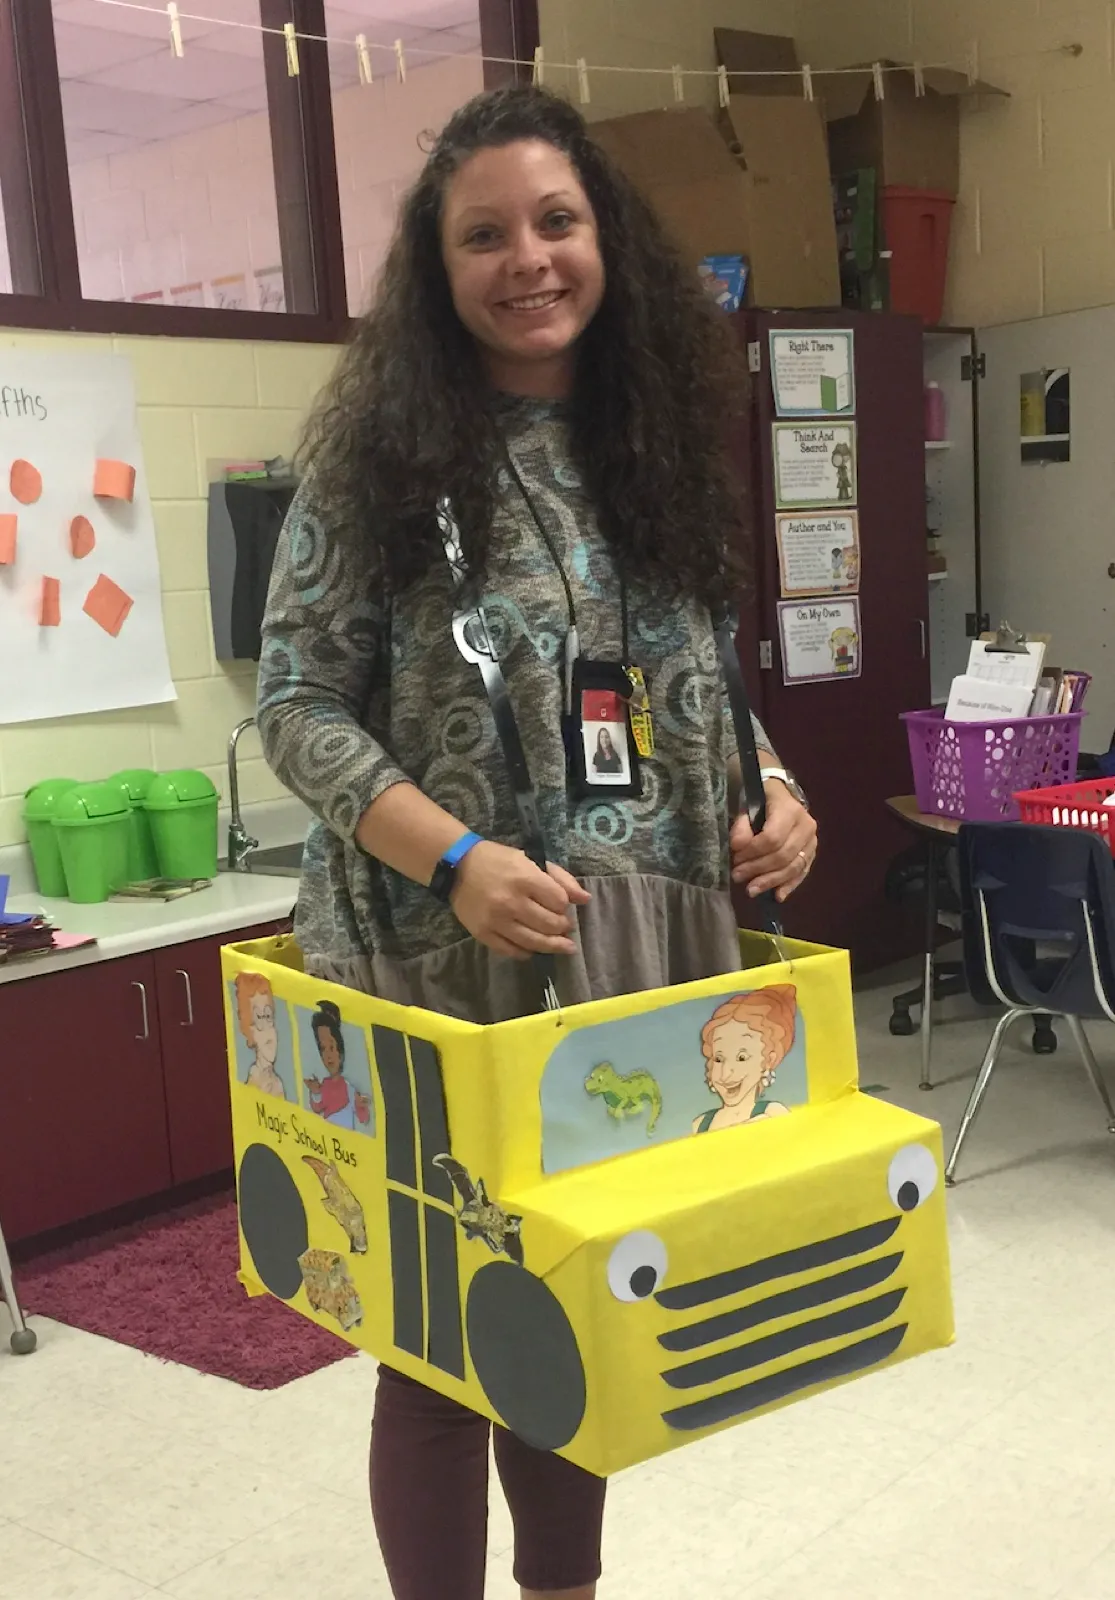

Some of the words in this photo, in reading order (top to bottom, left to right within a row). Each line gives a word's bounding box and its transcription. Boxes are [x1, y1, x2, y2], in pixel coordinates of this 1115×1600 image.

[789, 340, 810, 354] Right
[811, 340, 834, 351] There
[0, 385, 48, 421] fths
[793, 430, 817, 442] Think
[818, 430, 834, 441] And
[800, 442, 828, 453] Search
[788, 522, 815, 533] Author
[817, 521, 832, 532] and
[833, 520, 846, 531] You
[797, 609, 808, 620] On
[809, 608, 821, 621] My
[822, 608, 841, 618] Own
[256, 1101, 289, 1144] Magic
[291, 1113, 328, 1157] School
[332, 1137, 357, 1168] Bus
